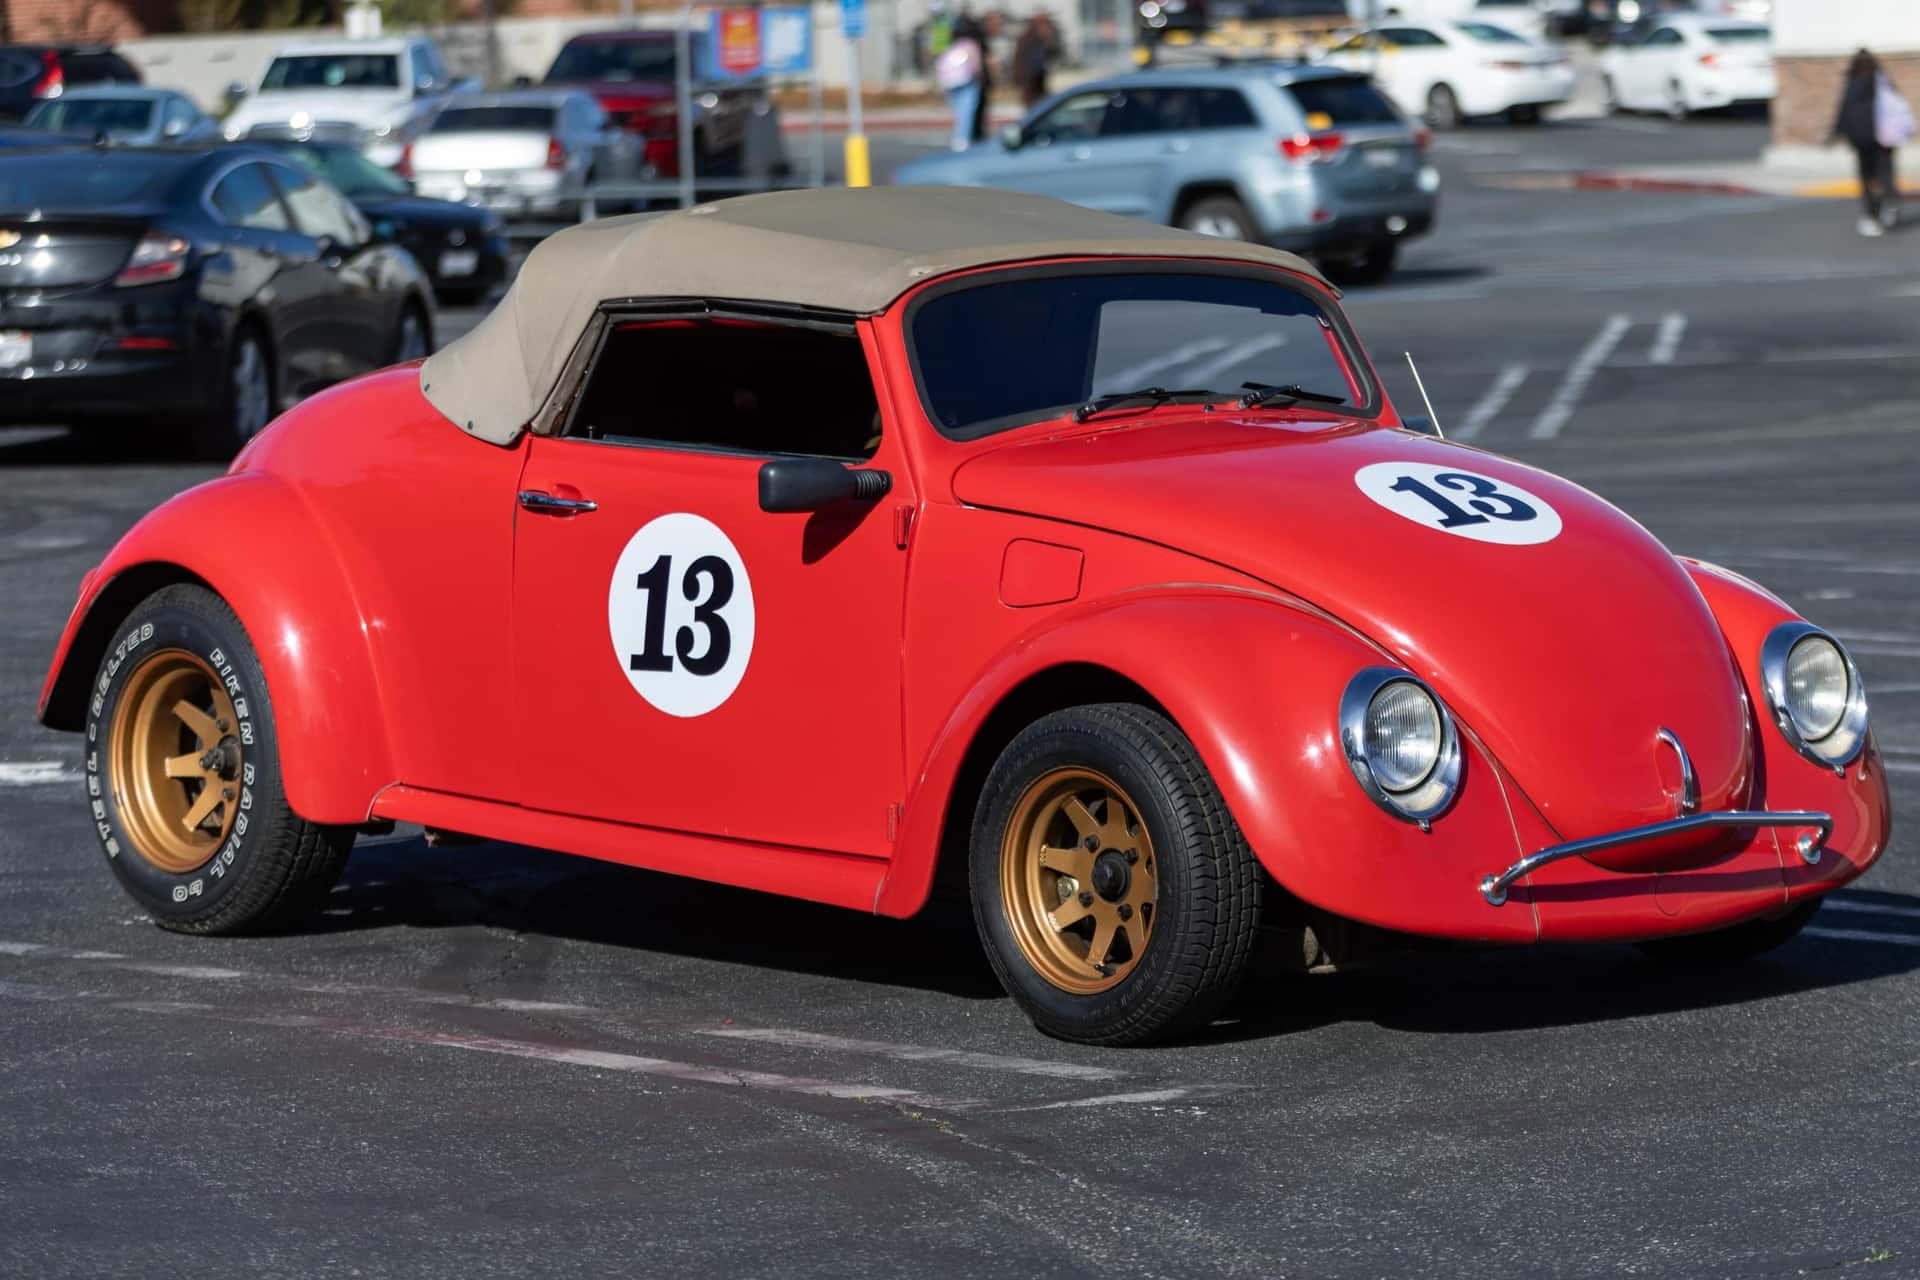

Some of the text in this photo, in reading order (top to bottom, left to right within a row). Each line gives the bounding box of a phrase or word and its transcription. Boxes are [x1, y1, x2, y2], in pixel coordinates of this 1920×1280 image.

[1389, 473, 1538, 528] 13
[630, 555, 734, 676] 13
[209, 648, 254, 745] RIKEN
[210, 763, 255, 878] RADIAL
